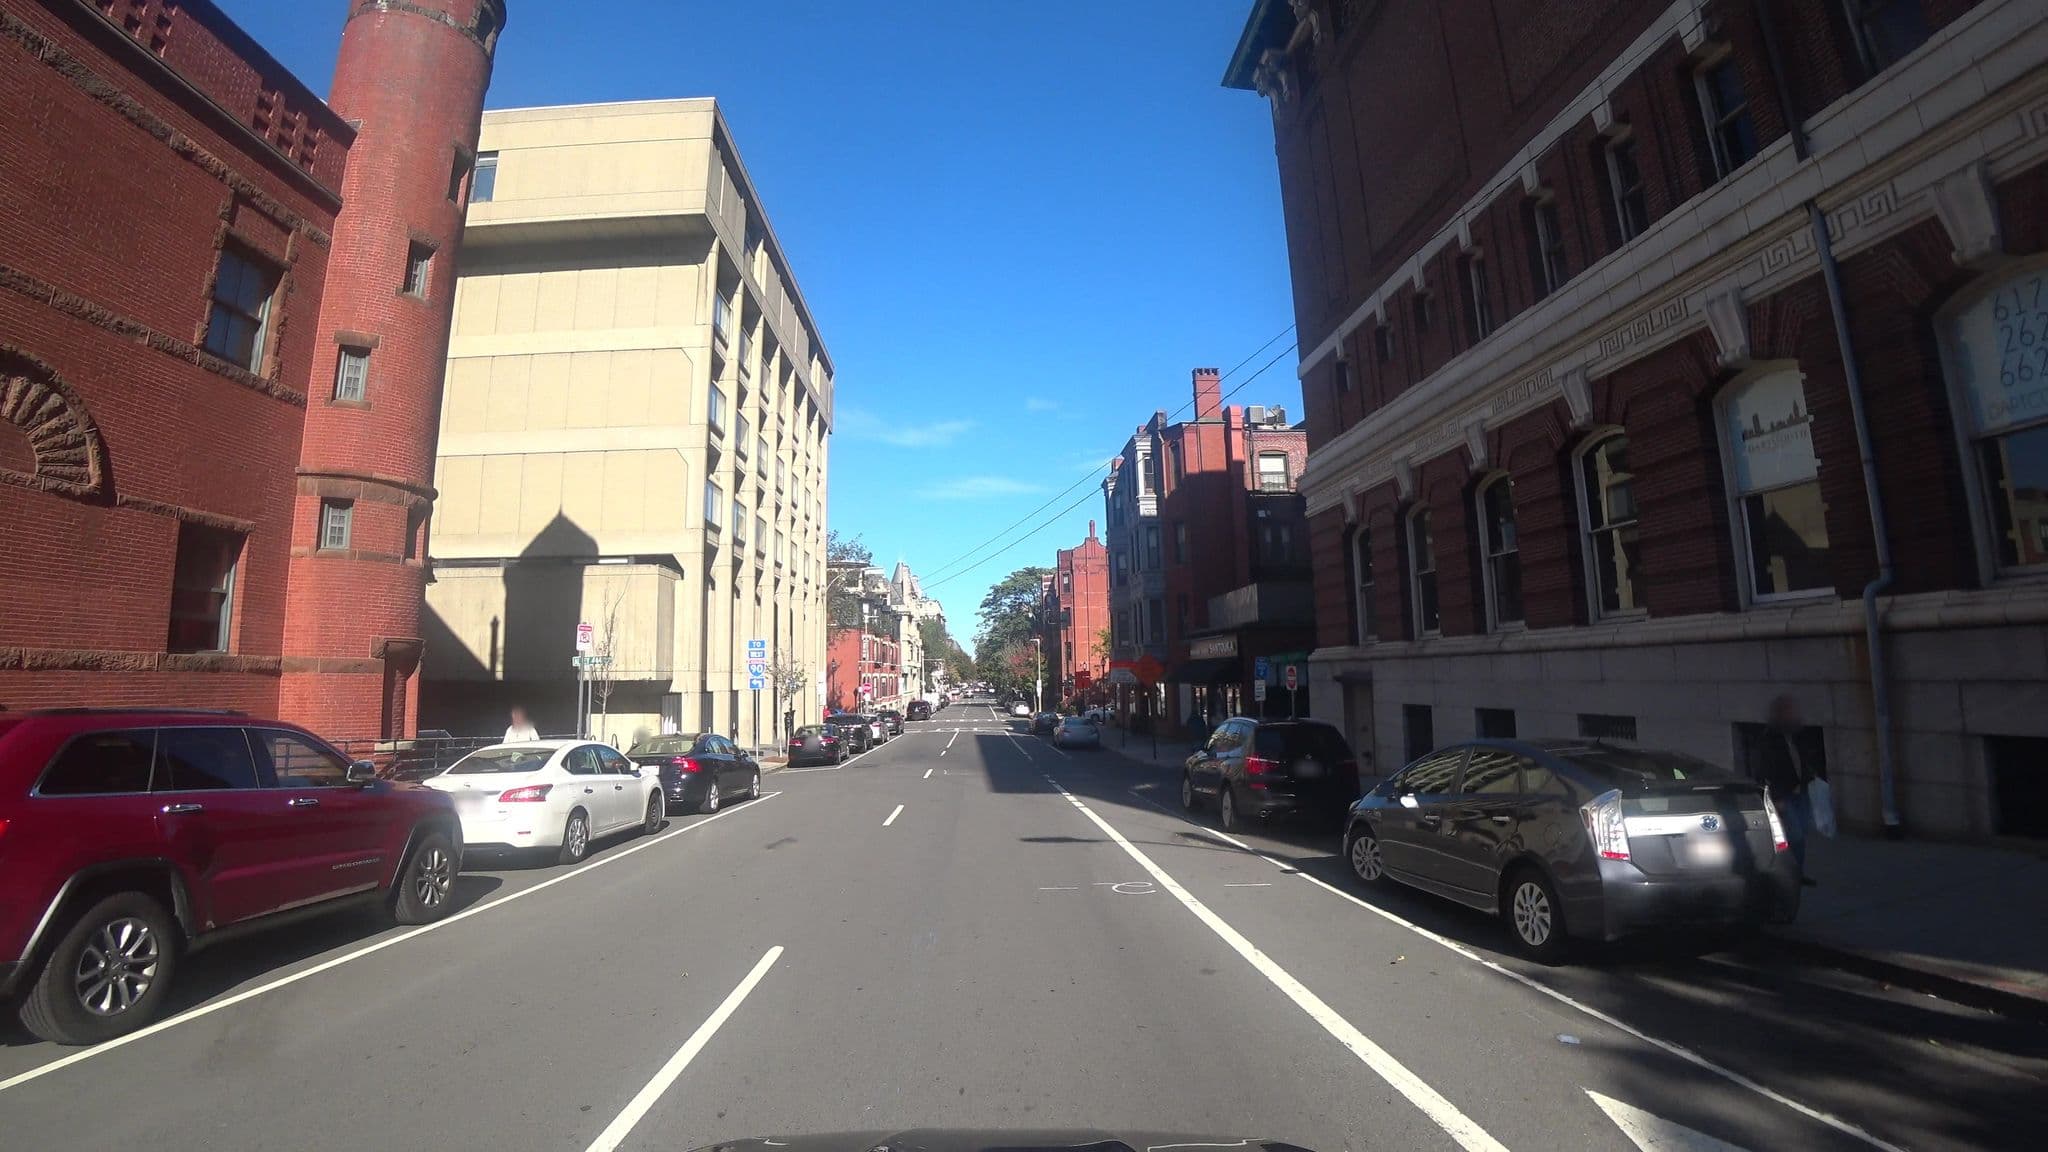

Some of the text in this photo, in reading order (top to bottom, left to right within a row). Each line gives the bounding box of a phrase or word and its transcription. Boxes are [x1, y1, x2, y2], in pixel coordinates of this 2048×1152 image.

[1992, 277, 2042, 321] 617
[1999, 311, 2048, 354] 262
[750, 664, 763, 674] 90
